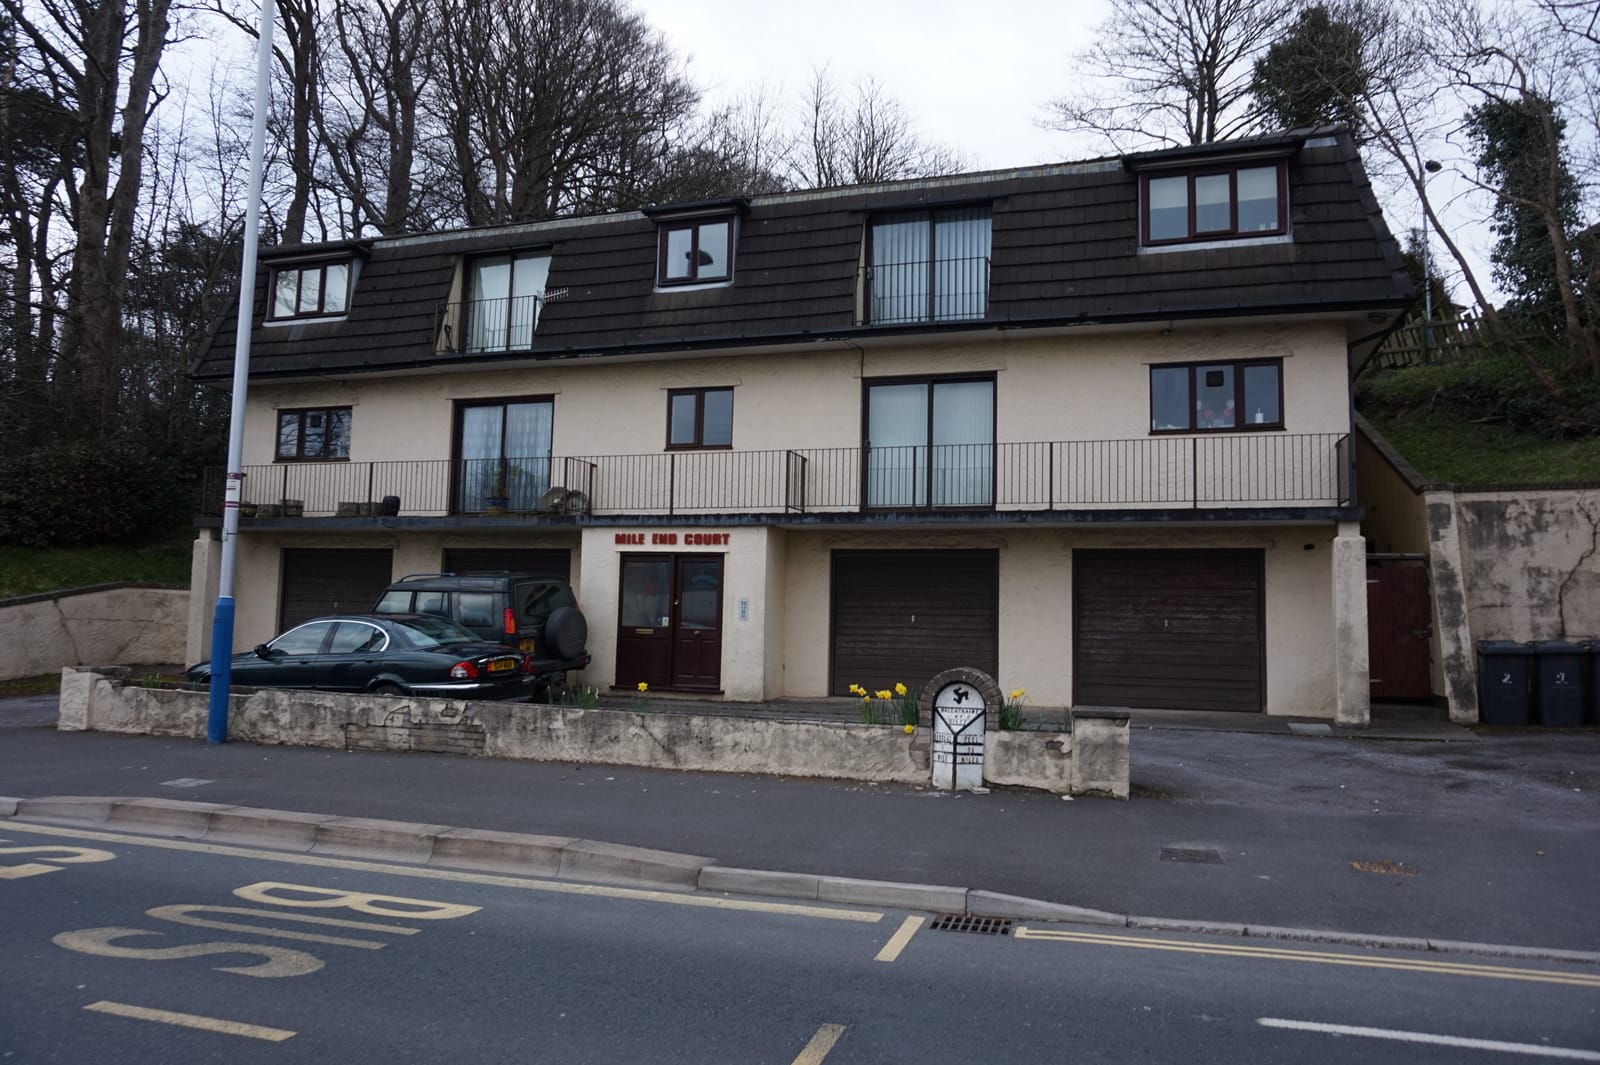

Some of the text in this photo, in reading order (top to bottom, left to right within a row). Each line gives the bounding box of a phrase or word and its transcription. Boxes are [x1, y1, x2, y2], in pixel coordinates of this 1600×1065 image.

[614, 533, 730, 545] MILE END COURT
[51, 881, 484, 978] BUS
